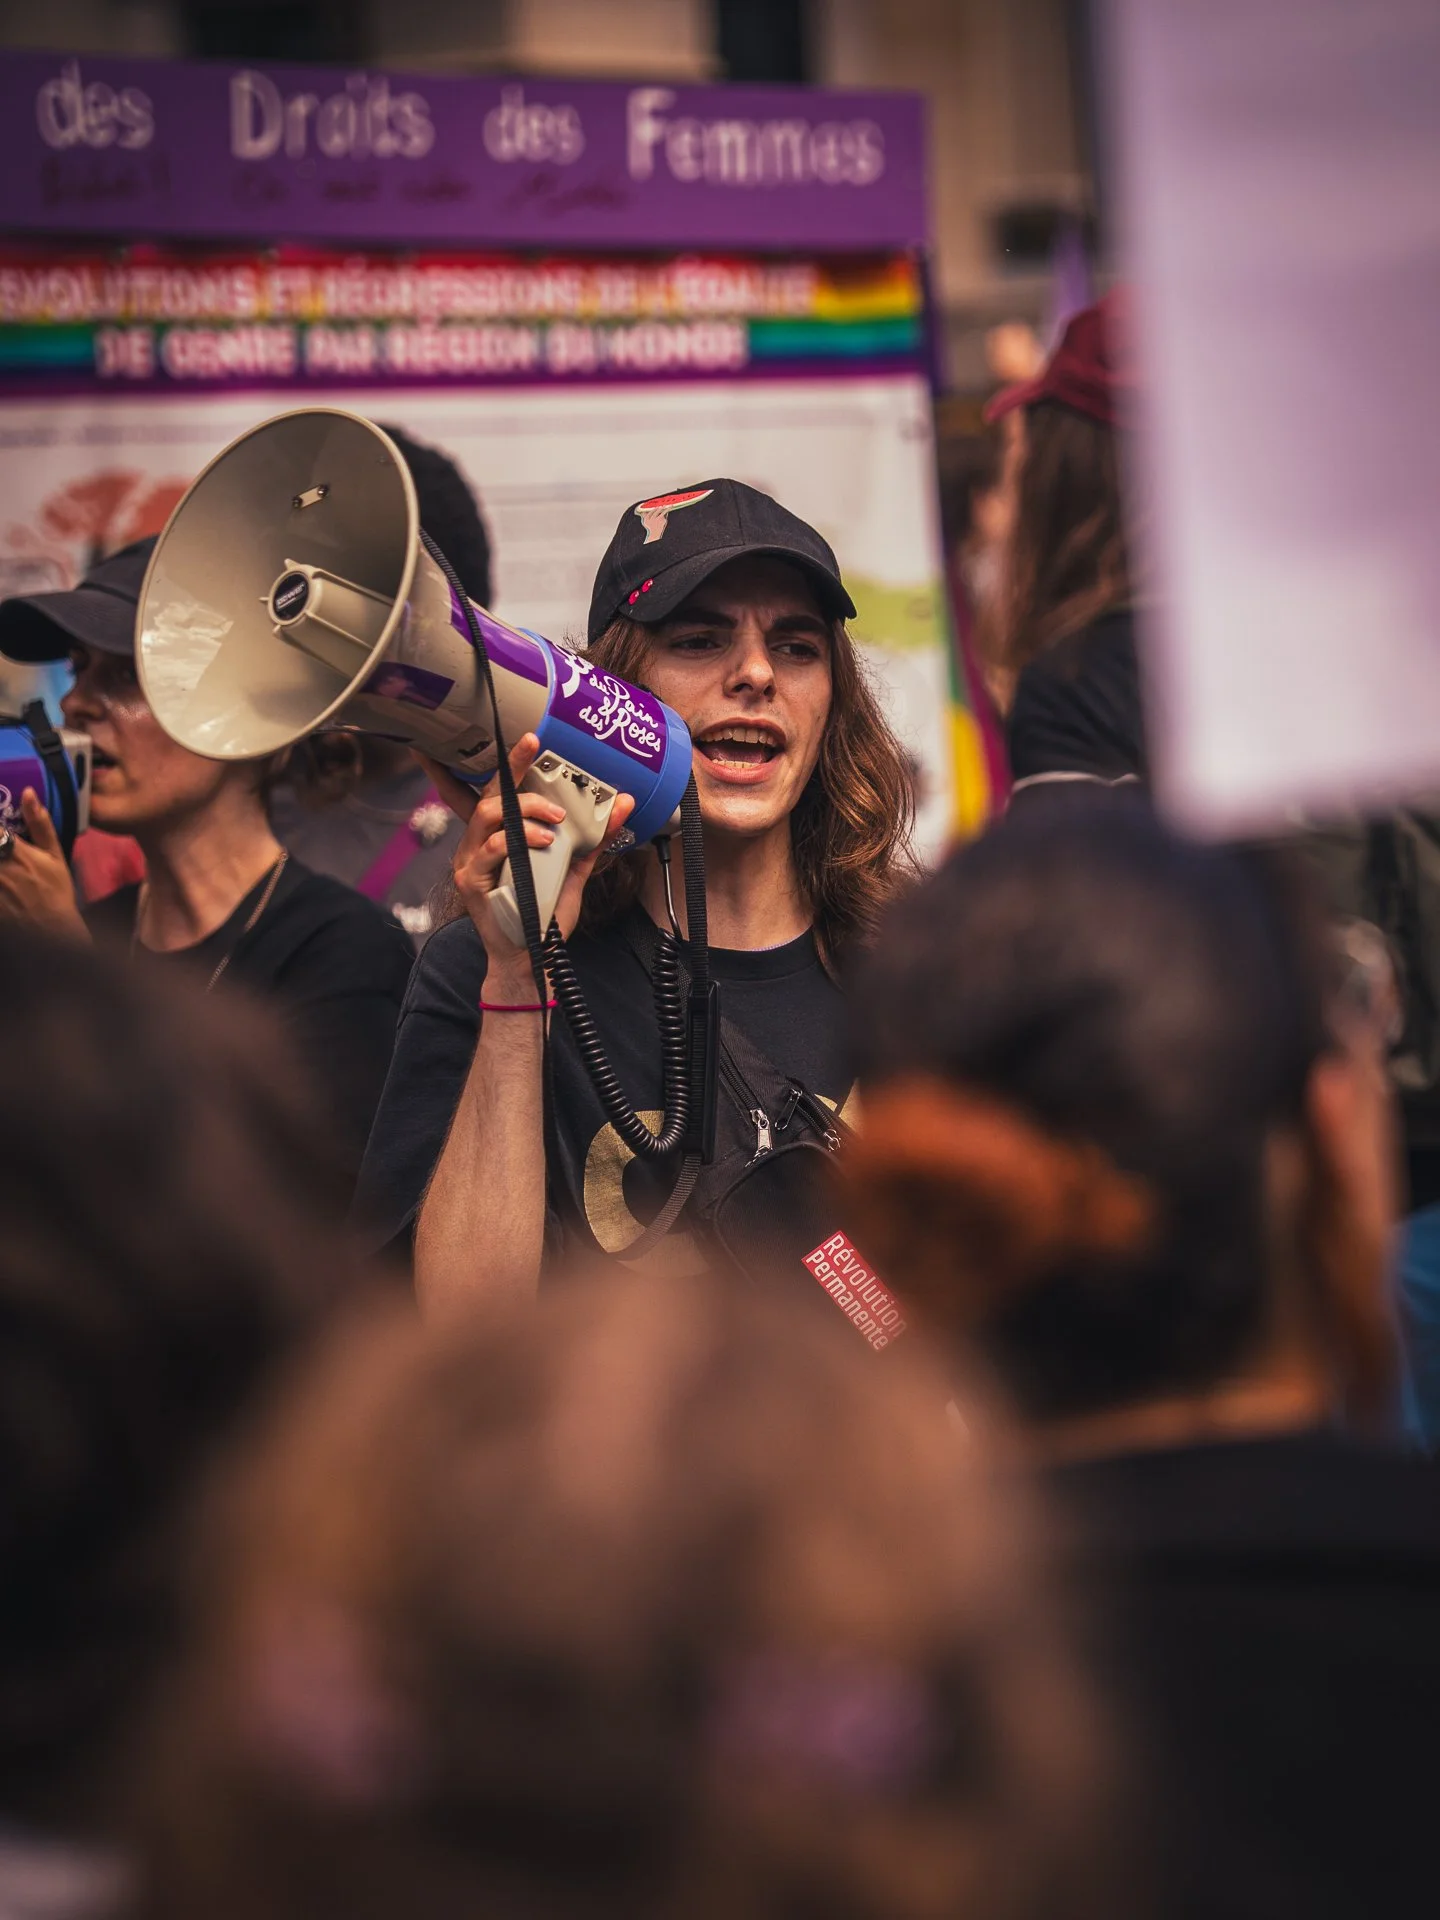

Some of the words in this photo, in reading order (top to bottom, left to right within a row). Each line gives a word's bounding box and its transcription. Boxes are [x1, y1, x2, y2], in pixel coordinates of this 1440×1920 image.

[36, 56, 155, 150] des
[483, 82, 586, 165] des
[626, 86, 885, 187] Femmes
[579, 705, 603, 732] des
[594, 707, 662, 758] Roses
[589, 674, 610, 696] du
[604, 675, 659, 729] Pain
[805, 1249, 889, 1350] Permanente
[823, 1234, 907, 1337] Révolution
